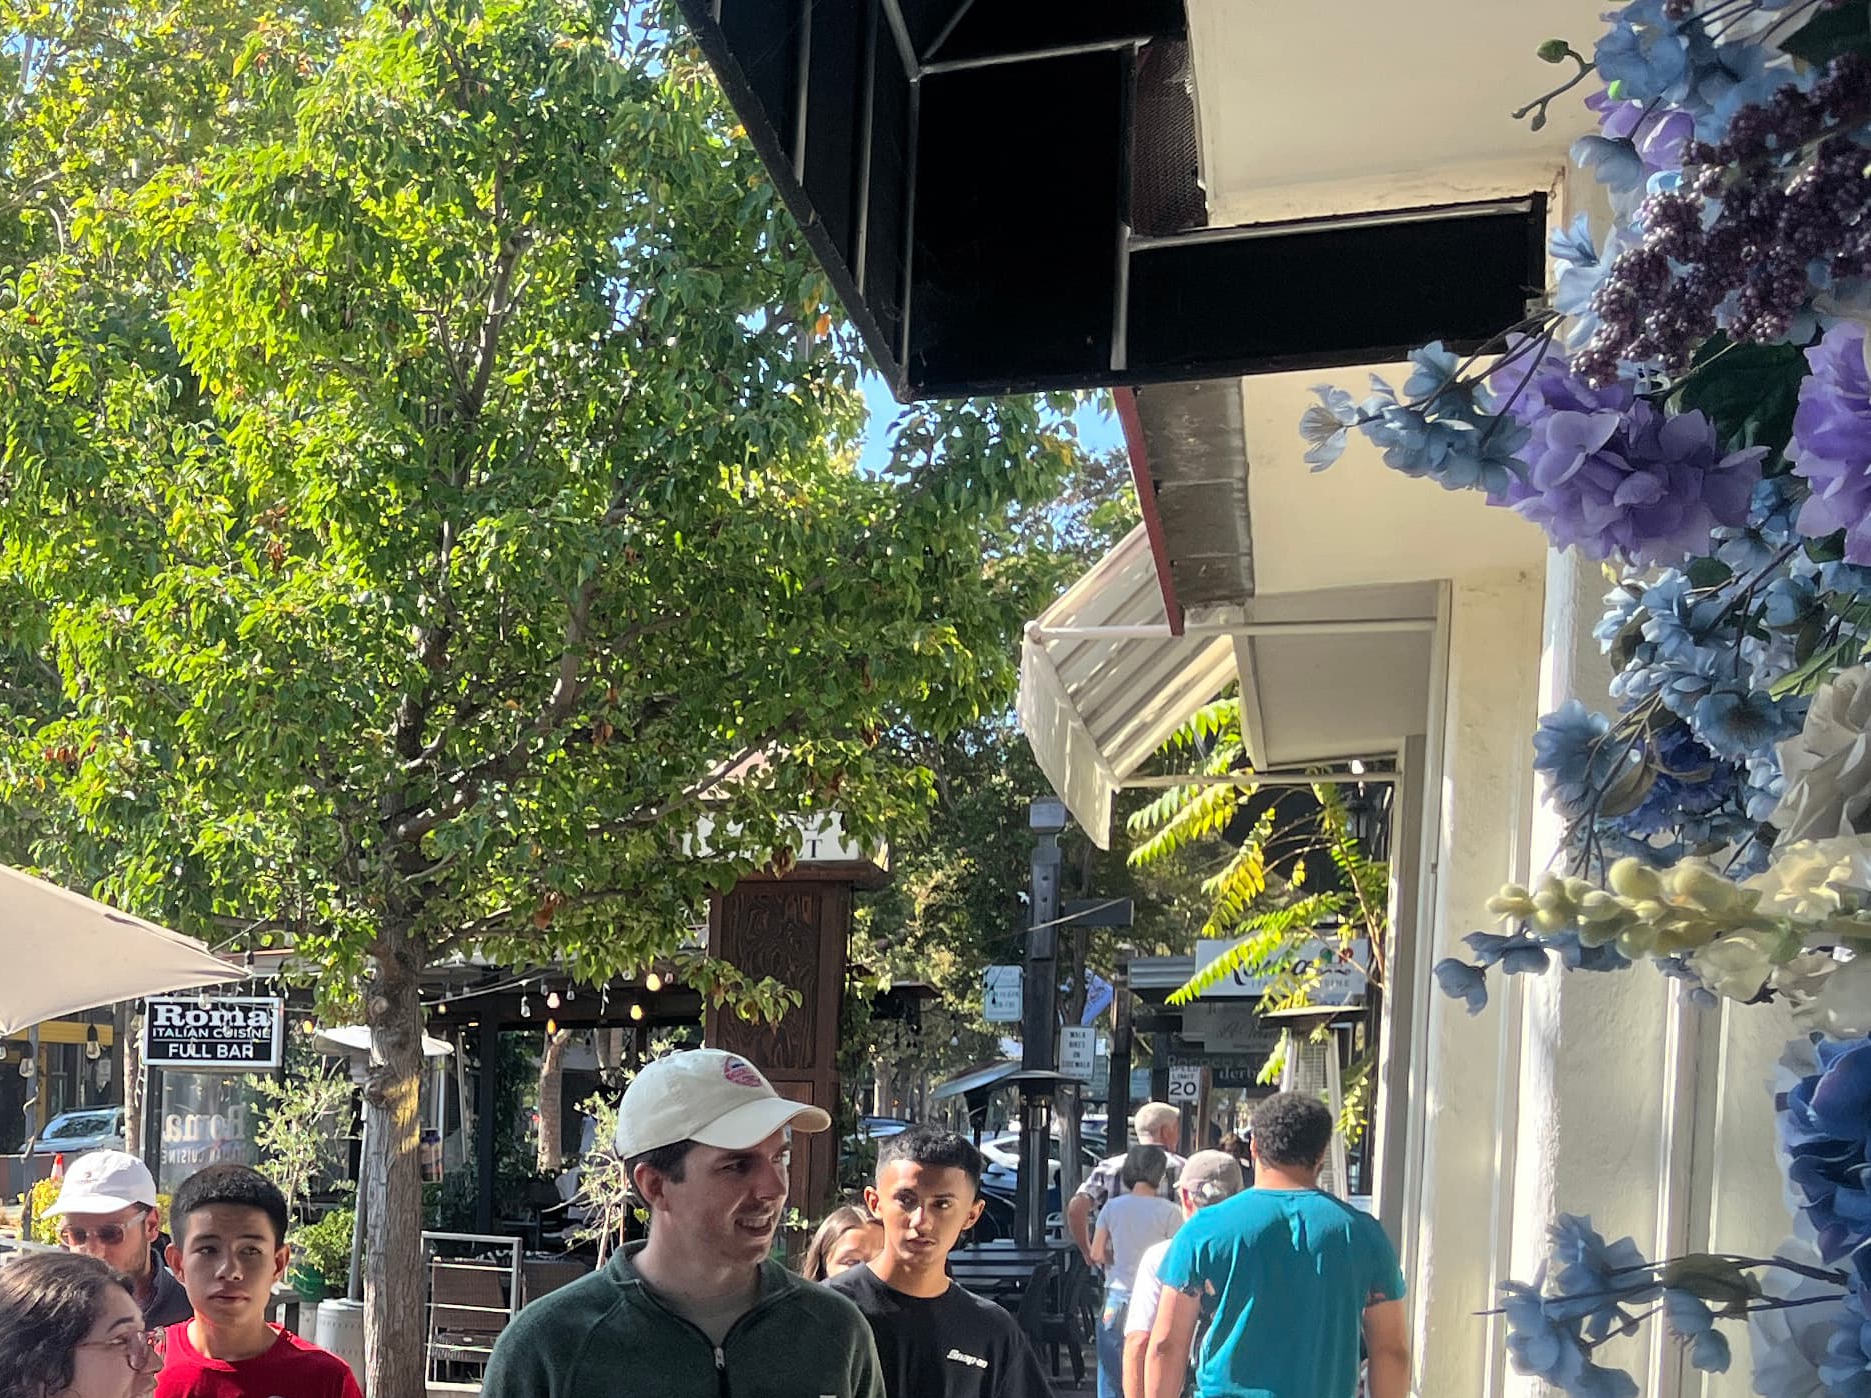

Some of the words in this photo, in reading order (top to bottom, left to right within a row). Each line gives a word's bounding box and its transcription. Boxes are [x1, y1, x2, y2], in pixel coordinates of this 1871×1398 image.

[153, 1004, 271, 1027] Roma
[153, 1028, 208, 1038] ITALIAN
[213, 1027, 271, 1039] CUISINE
[169, 1044, 211, 1058] FULL
[216, 1044, 254, 1058] BAR
[1172, 1072, 1195, 1080] LIMIT
[1170, 1081, 1196, 1096] 20
